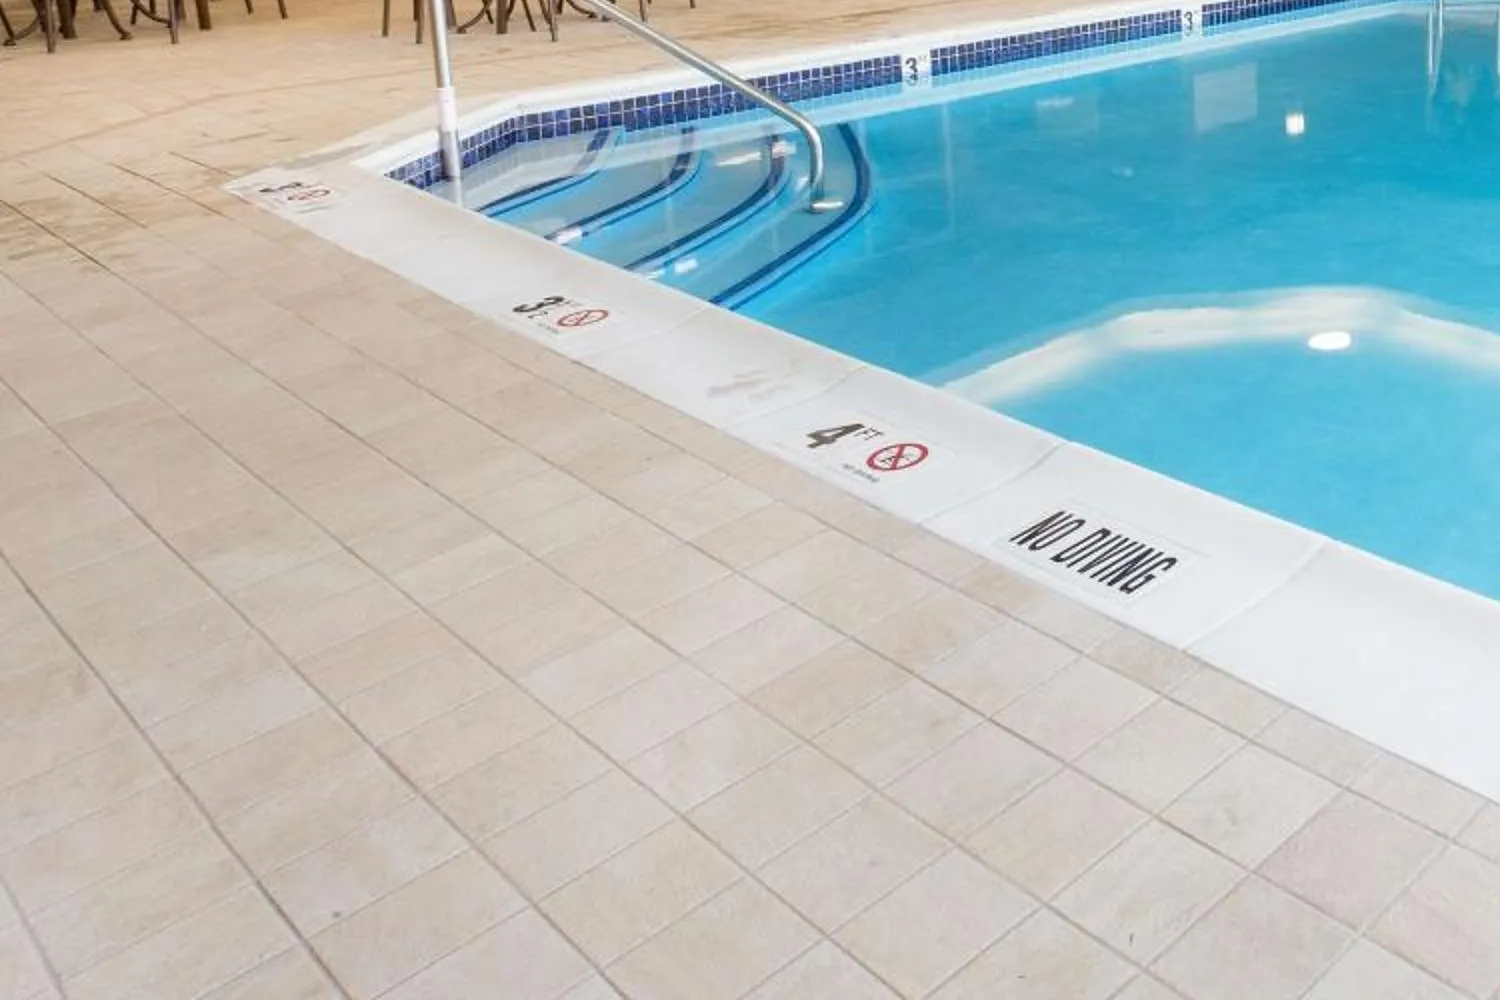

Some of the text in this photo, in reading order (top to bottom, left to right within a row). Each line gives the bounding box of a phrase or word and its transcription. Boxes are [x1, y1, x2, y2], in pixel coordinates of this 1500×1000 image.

[806, 423, 865, 448] 4
[1009, 510, 1178, 594] NO DIVING
